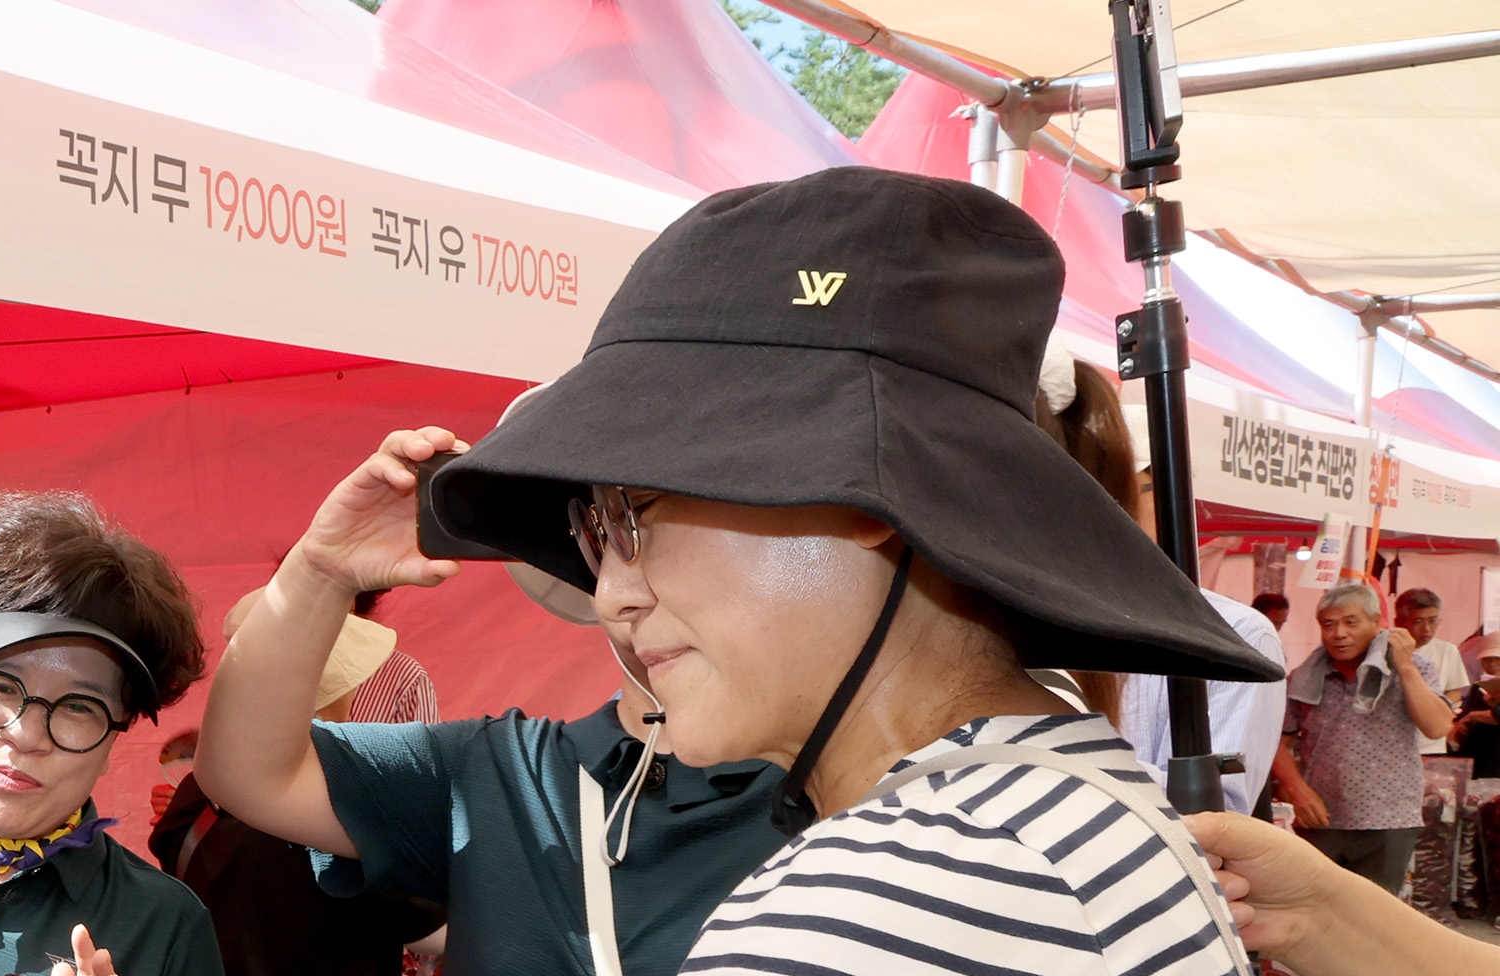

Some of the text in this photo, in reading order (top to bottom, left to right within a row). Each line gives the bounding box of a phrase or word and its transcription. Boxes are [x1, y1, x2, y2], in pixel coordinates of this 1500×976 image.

[56, 128, 578, 306] 꼭지 무 19,000원 꼭지 유 17,000원
[1221, 415, 1313, 493] 괴산청결고추
[1317, 440, 1357, 500] 직판장
